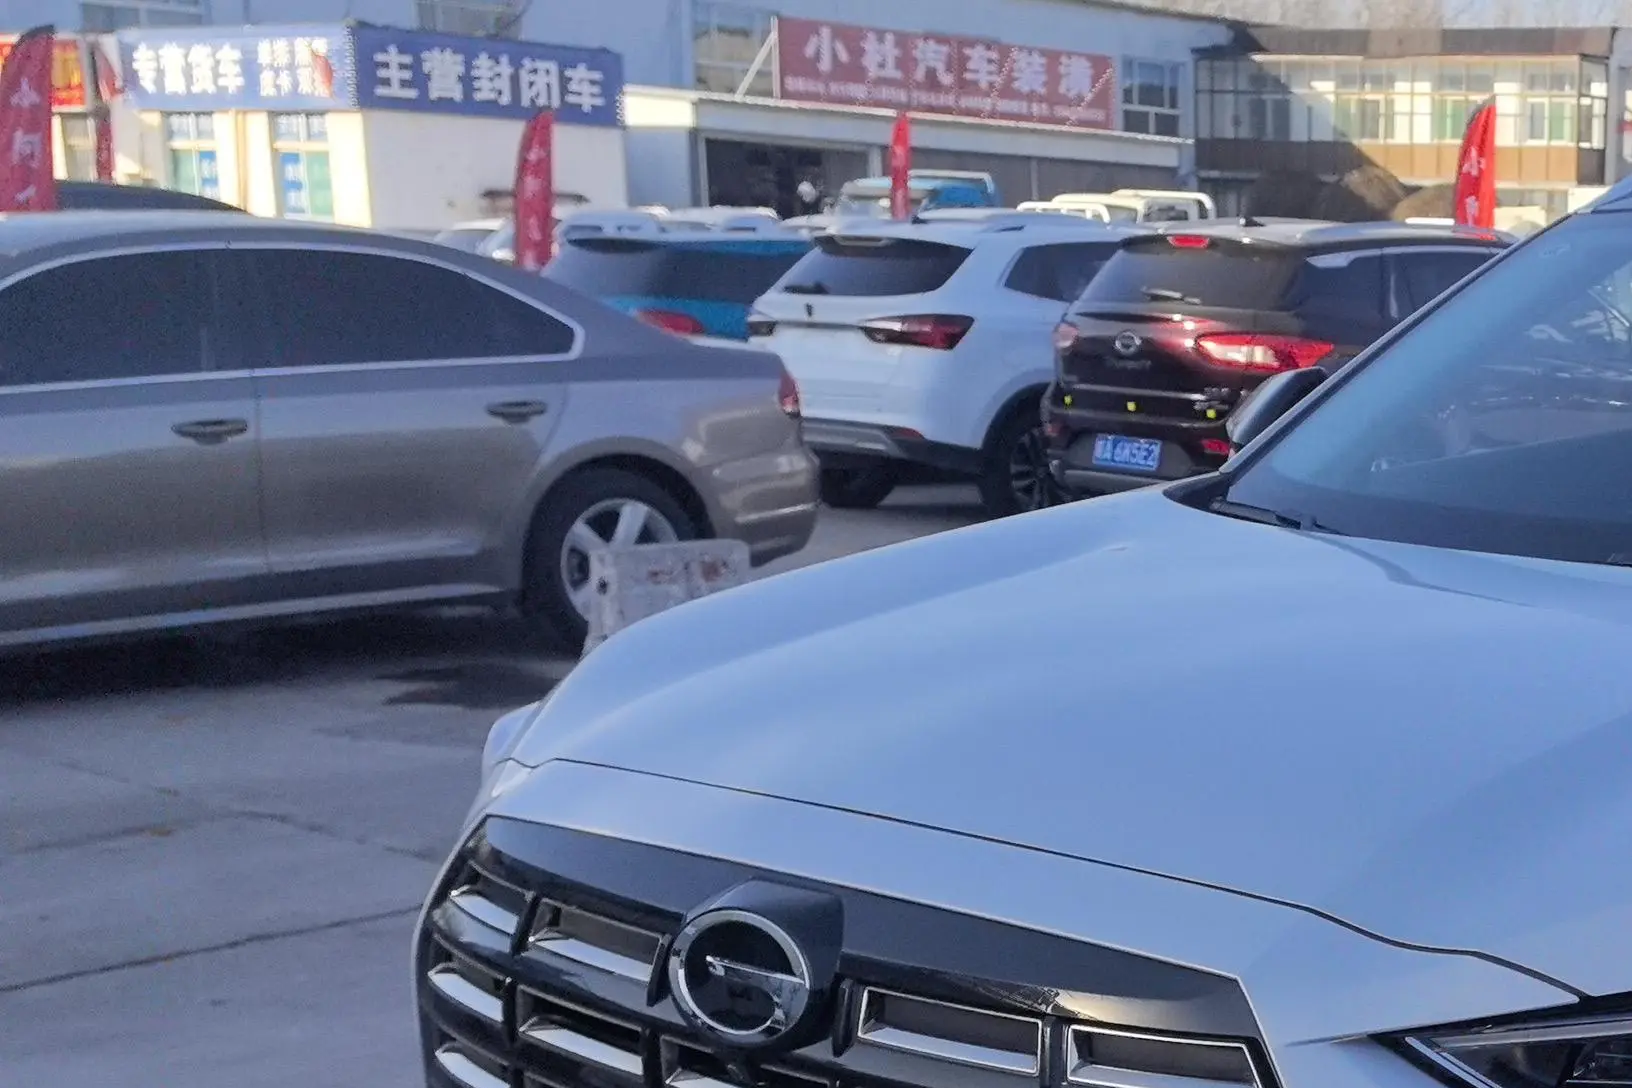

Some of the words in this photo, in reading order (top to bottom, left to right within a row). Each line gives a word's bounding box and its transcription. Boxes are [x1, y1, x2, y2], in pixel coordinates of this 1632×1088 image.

[373, 44, 606, 114] 主营封闭车
